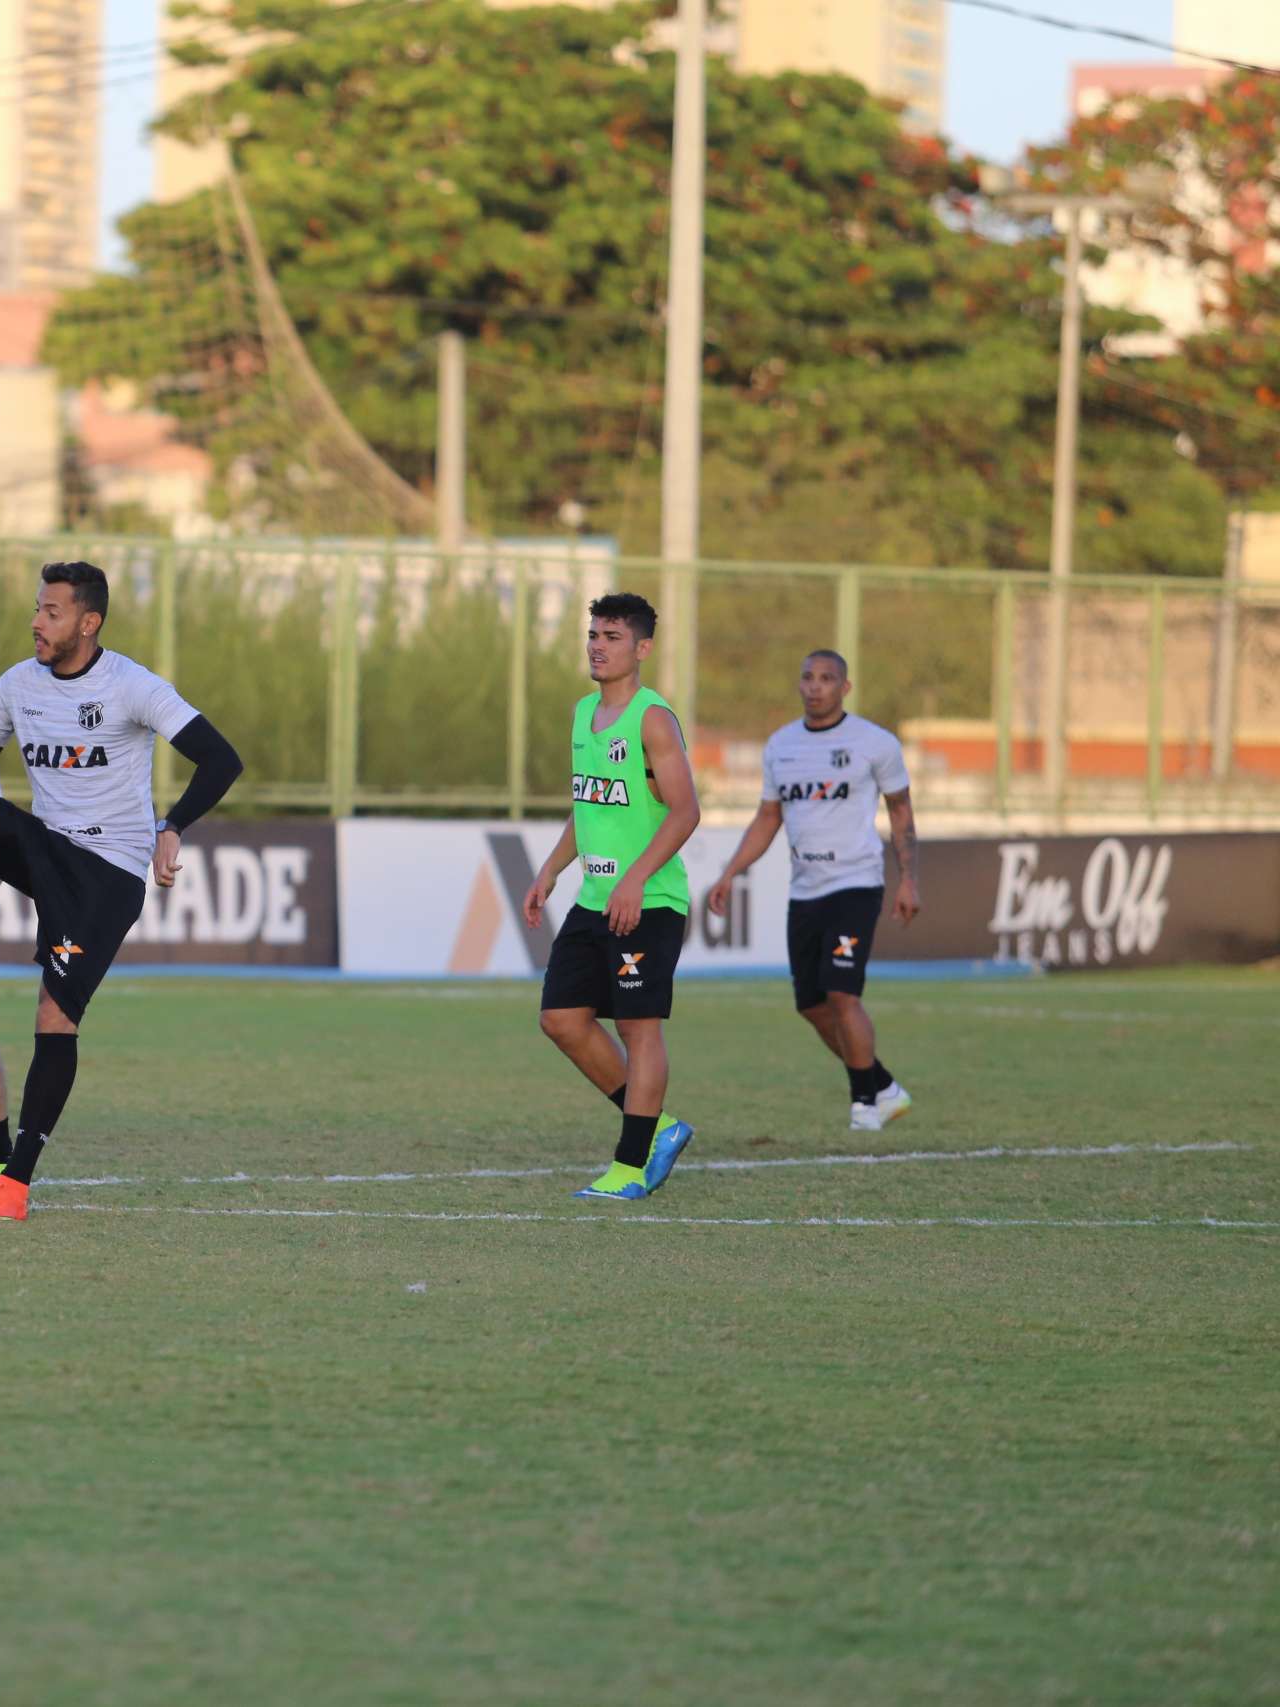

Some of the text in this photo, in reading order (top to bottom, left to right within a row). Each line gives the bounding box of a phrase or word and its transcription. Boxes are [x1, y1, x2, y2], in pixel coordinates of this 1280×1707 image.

[22, 742, 109, 769] CAIXA
[778, 781, 849, 802] CAIXA
[1082, 837, 1173, 955] Off
[618, 979, 644, 990] Topper
